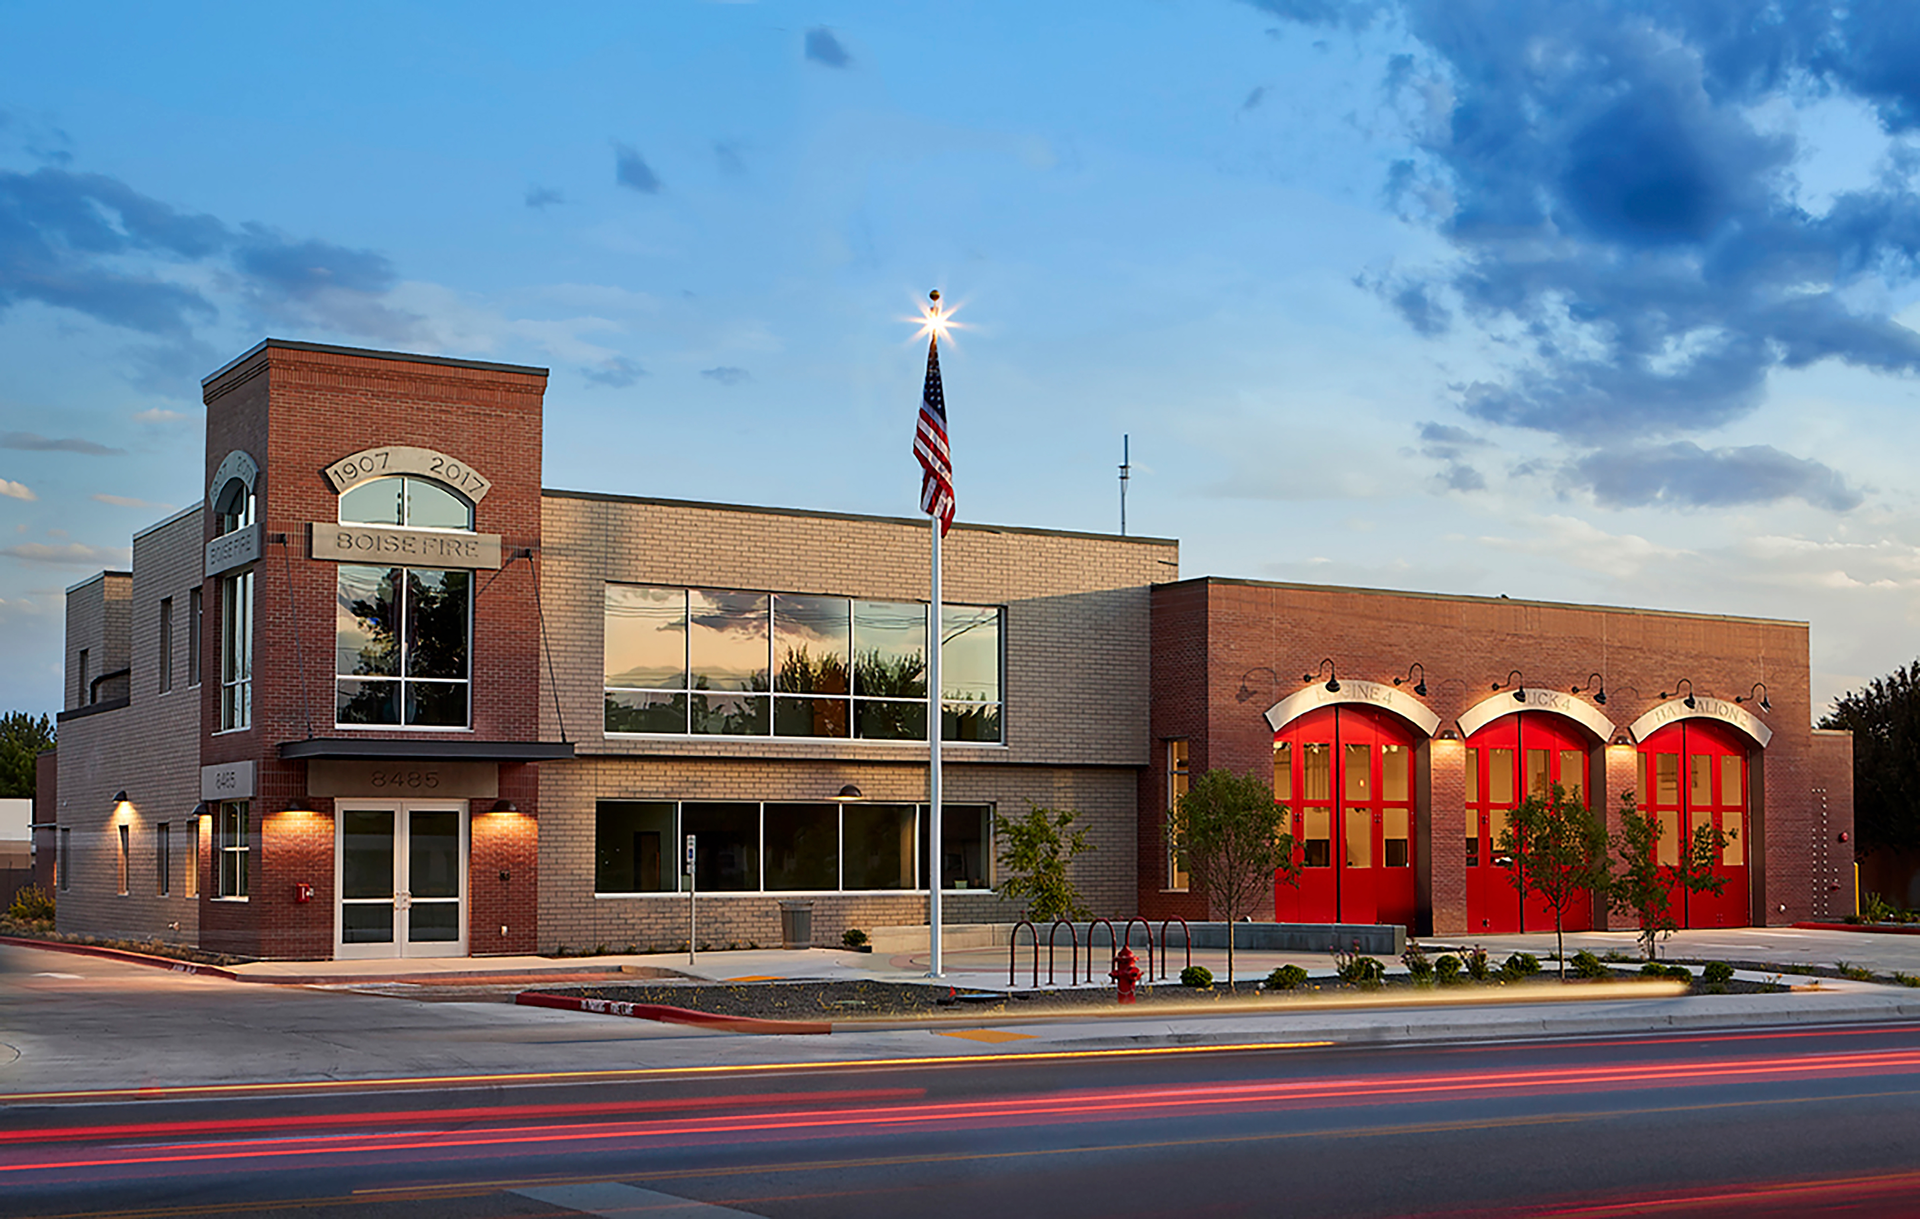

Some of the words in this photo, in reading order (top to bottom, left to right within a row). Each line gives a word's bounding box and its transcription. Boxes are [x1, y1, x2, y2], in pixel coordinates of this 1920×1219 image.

[332, 452, 390, 484] 1907
[429, 457, 485, 493] 2017
[337, 532, 416, 555] BOISE
[423, 537, 479, 558] FIRE
[1382, 691, 1393, 705] 4
[1562, 698, 1571, 711] 4
[371, 770, 440, 789] 8485
